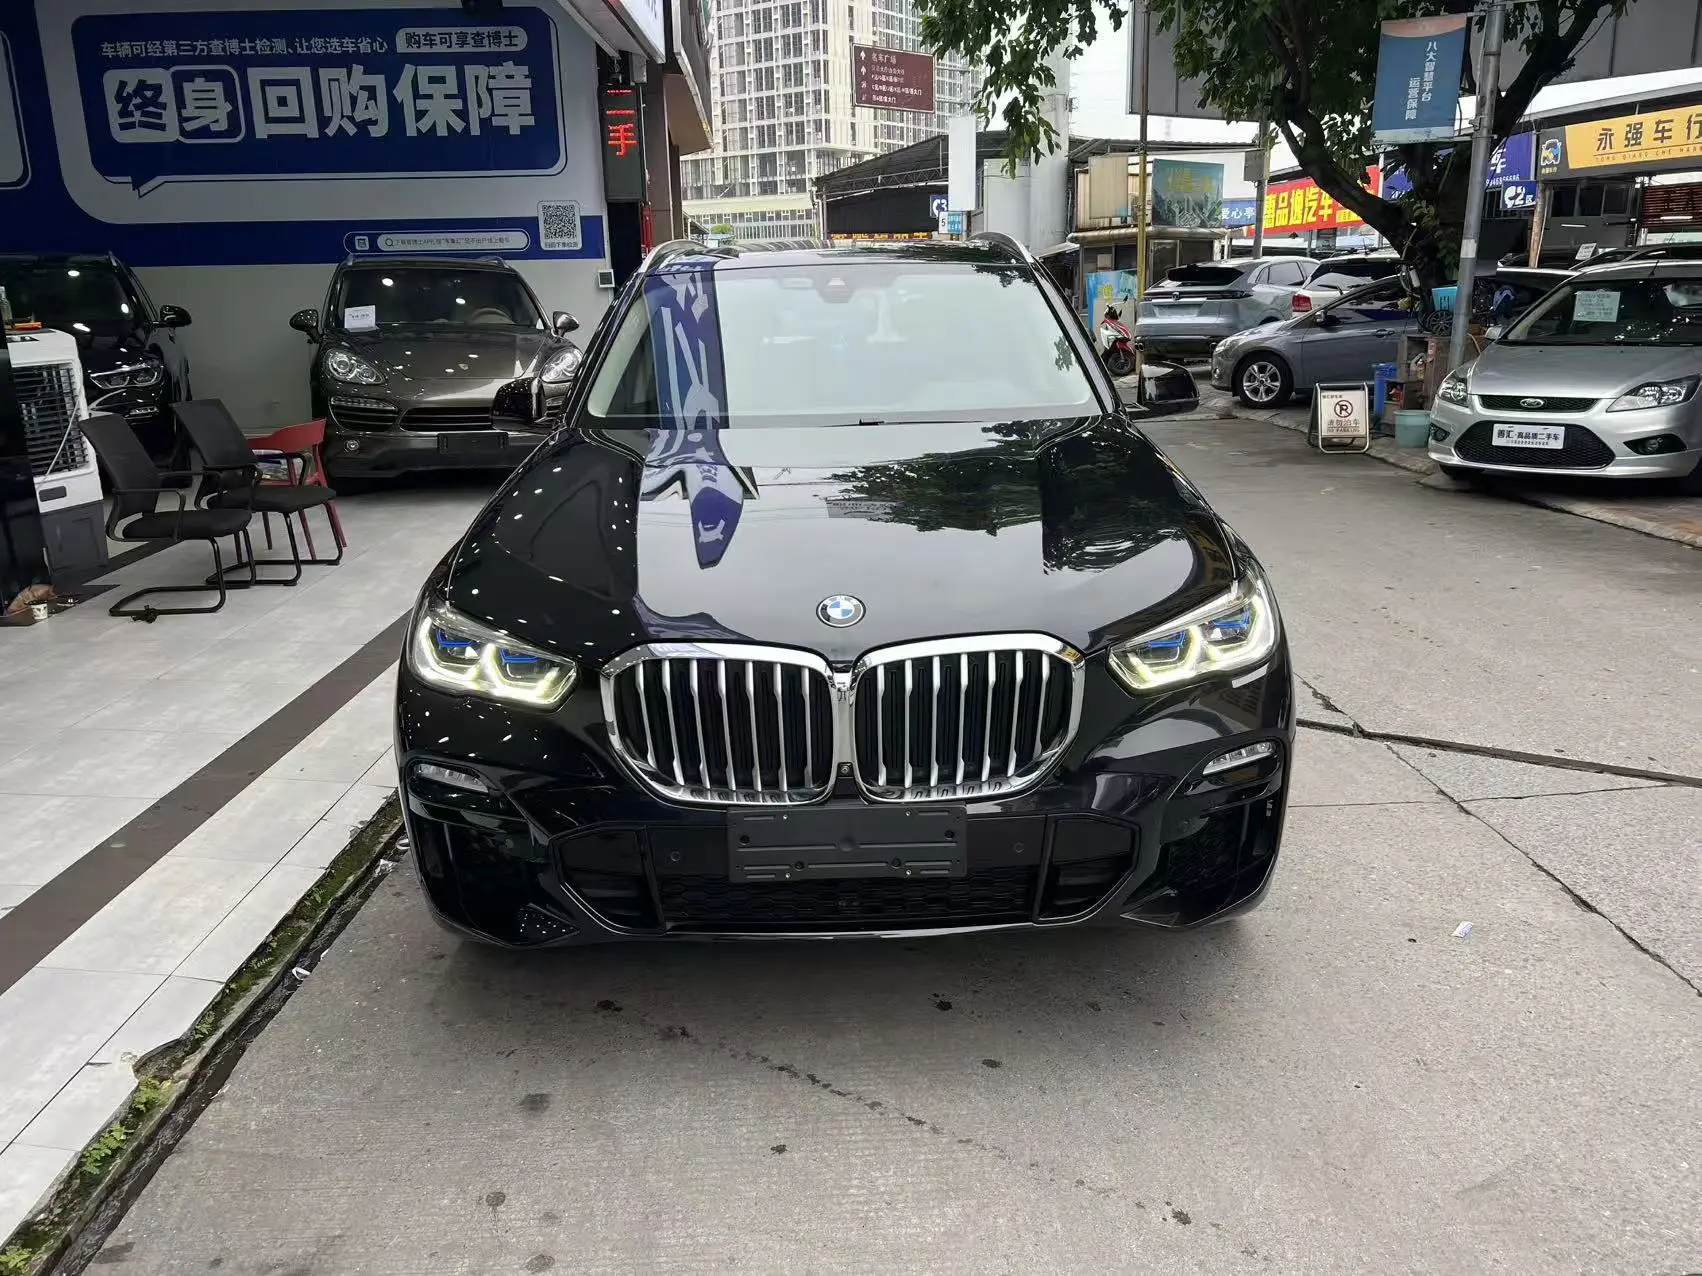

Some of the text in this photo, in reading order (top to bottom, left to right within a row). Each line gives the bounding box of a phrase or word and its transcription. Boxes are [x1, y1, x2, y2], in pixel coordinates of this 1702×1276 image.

[405, 30, 519, 49] 购车可享查博士
[1421, 41, 1438, 101] 八大智慧平台
[105, 60, 536, 142] 终身回购保障
[1405, 77, 1420, 120] 运营保障
[1596, 113, 1702, 151] 永强车行
